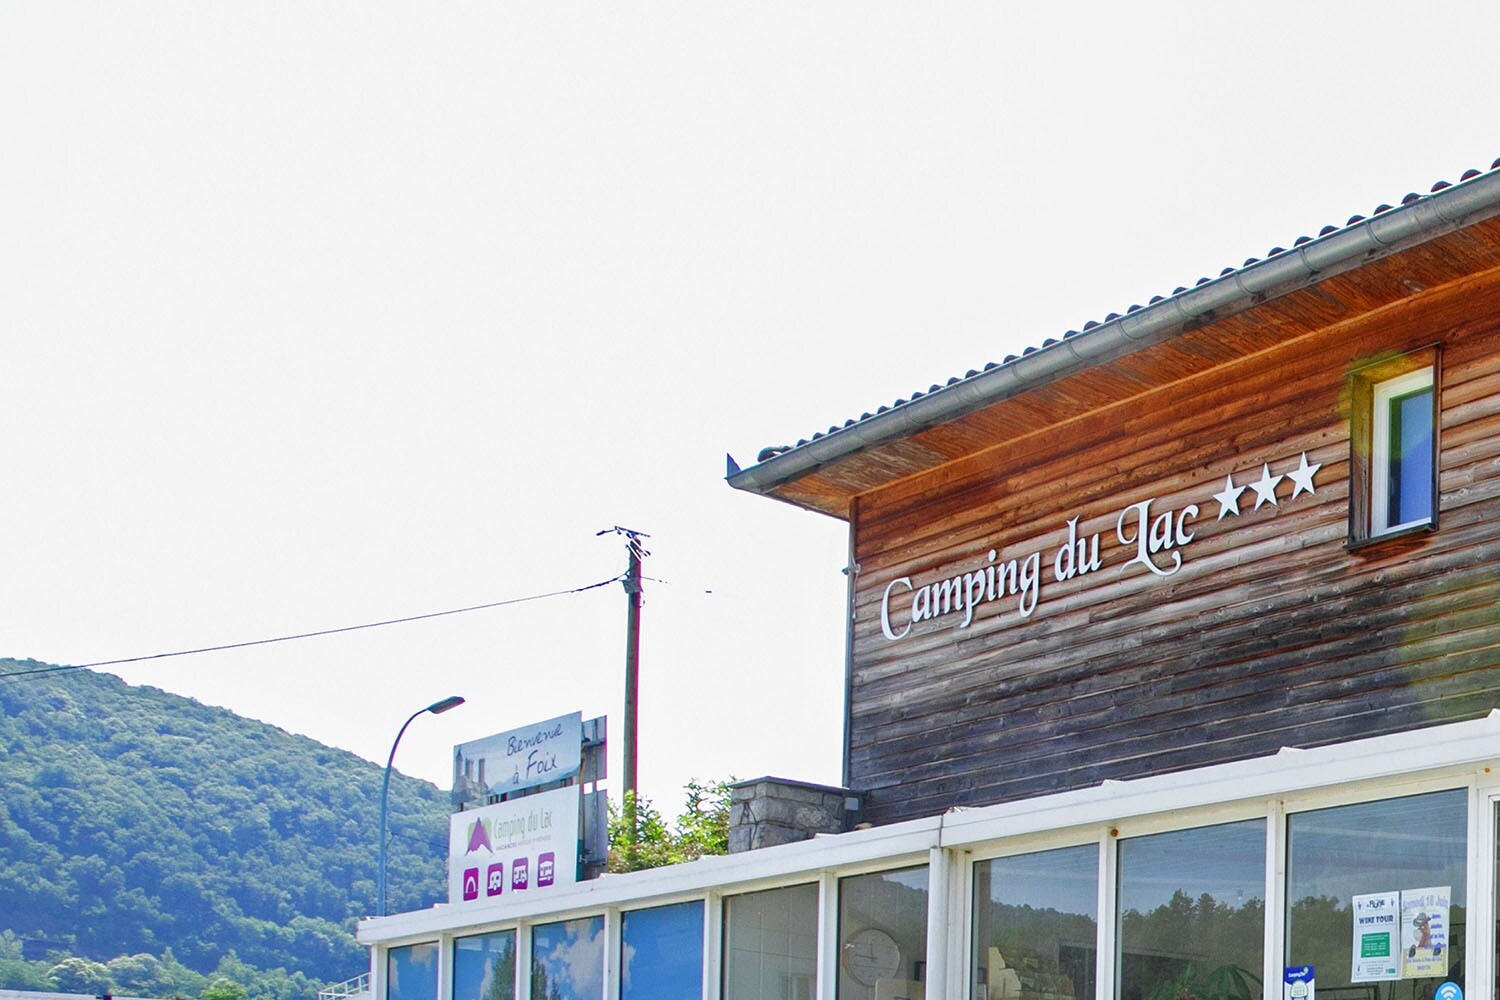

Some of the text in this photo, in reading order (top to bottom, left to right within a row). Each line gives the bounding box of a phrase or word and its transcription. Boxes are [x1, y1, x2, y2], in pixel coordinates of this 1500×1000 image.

[880, 497, 1199, 641] Camping du Lac
[507, 724, 563, 756] Bienvenue
[526, 750, 557, 779] Foix
[494, 812, 525, 842] Camping
[1359, 914, 1393, 925] WINE TOUR
